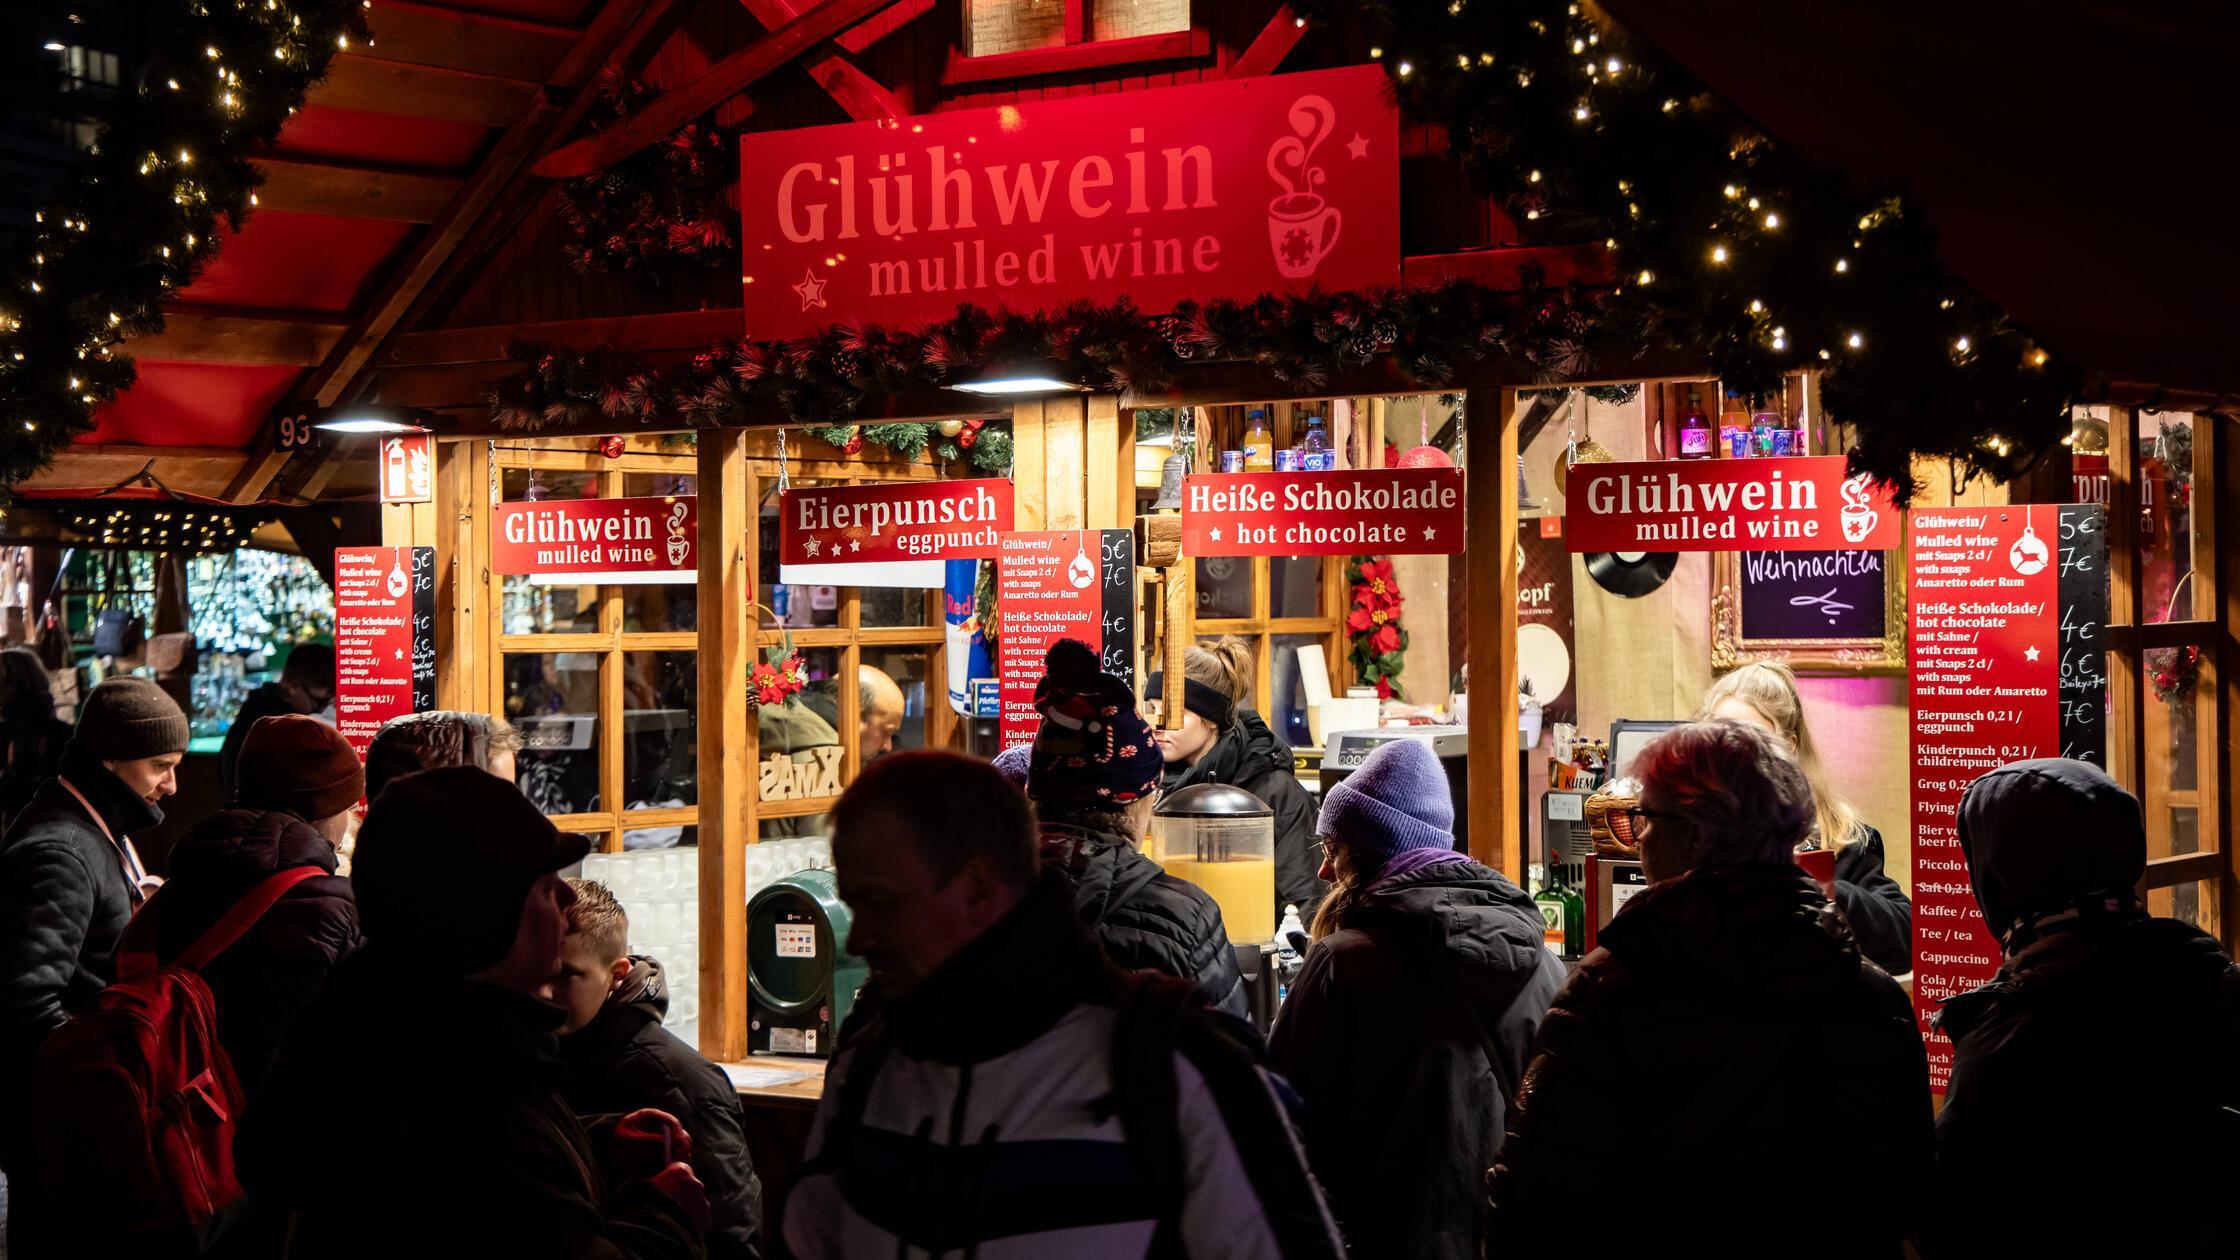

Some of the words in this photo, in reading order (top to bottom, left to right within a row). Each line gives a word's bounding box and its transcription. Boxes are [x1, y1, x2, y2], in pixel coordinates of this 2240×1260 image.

[778, 127, 1218, 244] Glühwein
[868, 233, 1056, 296] mulled
[1080, 227, 1220, 280] wine
[1190, 483, 1275, 513] Heiße
[1284, 480, 1456, 511] Schokolade
[1588, 471, 1818, 514] Glühwein
[798, 487, 997, 536] Eierpunsch
[504, 508, 653, 544] Glühwein
[1636, 516, 1736, 540] mulled
[1747, 516, 1819, 538] wine
[1915, 515, 1987, 529] Glühwein/
[2060, 513, 2095, 540] 5€
[1237, 522, 1278, 544] hot
[1286, 521, 1406, 543] chocolate
[896, 528, 998, 555] eggpunch
[1003, 539, 1052, 551] Glühwein/
[1916, 534, 1962, 547] Mulled
[1964, 535, 1998, 546] wine
[537, 543, 603, 565] mulled
[608, 544, 654, 562] wine
[1102, 535, 1125, 562] 5€
[411, 549, 430, 571] 5€
[1003, 555, 1035, 565] Mulled
[1037, 555, 1060, 565] wine
[1915, 551, 1934, 561] mit
[1935, 551, 1966, 562] Snaps
[1967, 550, 1974, 560] 2
[2059, 547, 2092, 577] 7€
[1003, 569, 1016, 577] mit
[1016, 568, 1038, 578] Snaps
[1746, 550, 1881, 584] Weihnachten
[1915, 564, 1939, 574] with
[1940, 566, 1970, 576] snaps
[412, 573, 431, 593] 7€
[1102, 564, 1126, 589] 7€
[1916, 578, 1968, 587] Amaretto
[1970, 577, 1996, 587] oder
[1999, 577, 2024, 587] Rum
[1003, 580, 1020, 588] with
[1020, 581, 1041, 589] snaps
[1003, 591, 1040, 599] Amaretto
[1040, 590, 1060, 598] oder
[1061, 590, 1078, 598] Rum
[946, 594, 971, 615] Red
[1916, 602, 1956, 617] Heiße
[1959, 602, 2045, 617] Schokolade/
[1004, 611, 1032, 621] Heiße
[1034, 611, 1092, 623] Schokolade/
[1102, 611, 1126, 635] 4€
[1916, 616, 1938, 628] hot
[1941, 616, 2006, 628] chocolate
[1004, 623, 1020, 633] hot
[1021, 623, 1066, 633] chocolate
[2060, 605, 2096, 643] 4€
[1004, 636, 1017, 644] mit
[1018, 636, 1042, 644] Sahne
[1916, 632, 1935, 641] mit
[1937, 631, 1970, 641] Sahne
[413, 636, 430, 653] 6€
[1004, 647, 1021, 655] with
[1916, 645, 1941, 655] with
[1943, 647, 1978, 655] cream
[1103, 645, 1124, 667] 6€
[2061, 647, 2093, 678] 6€
[1004, 658, 1017, 666] mit
[1017, 658, 1039, 668] Snaps
[1916, 659, 1934, 668] mit
[1935, 659, 1966, 671] Snaps
[1968, 659, 1975, 668] 2
[1004, 669, 1021, 678] with
[1021, 671, 1043, 679] snaps
[1916, 672, 1940, 682] with
[1941, 674, 1971, 684] snaps
[1005, 681, 1018, 689] mit
[1019, 681, 1037, 689] Rum
[1917, 686, 1935, 695] mit
[1938, 686, 1963, 695] Rum
[1965, 686, 1992, 696] oder
[1994, 686, 2047, 696] Amaretto
[413, 692, 429, 707] 7€
[1005, 701, 1035, 712] Eierpu
[1917, 710, 1984, 723] Eierpunsch
[1987, 711, 2005, 722] 0,2
[2008, 711, 2012, 721] l
[2060, 701, 2095, 727] 7€
[1917, 721, 1974, 734] eggpunch
[1918, 745, 1995, 758] Kinderpunch
[2001, 746, 2019, 758] 0,2
[2023, 746, 2028, 757] l
[1918, 779, 1947, 792] Grog
[1949, 779, 1967, 793] 0,2
[1919, 801, 1955, 815] Flying
[1919, 825, 1944, 835] Bier
[1919, 836, 1946, 847] beer
[1949, 837, 1961, 847] fr
[1919, 859, 1961, 870] Piccolo
[1944, 883, 1962, 895] 0,2
[1966, 884, 1970, 894] l
[1920, 905, 1957, 916] Kaffee
[1969, 910, 1983, 918] co
[1920, 928, 1942, 939] Tee
[1954, 931, 1972, 940] tea
[1920, 951, 1989, 965] Cappuccino
[1921, 974, 1946, 985] Cola
[1959, 976, 1985, 987] Fant
[1921, 986, 1957, 998] Sprite
[1927, 1053, 1949, 1063] ach
[1929, 1076, 1949, 1086] itte
